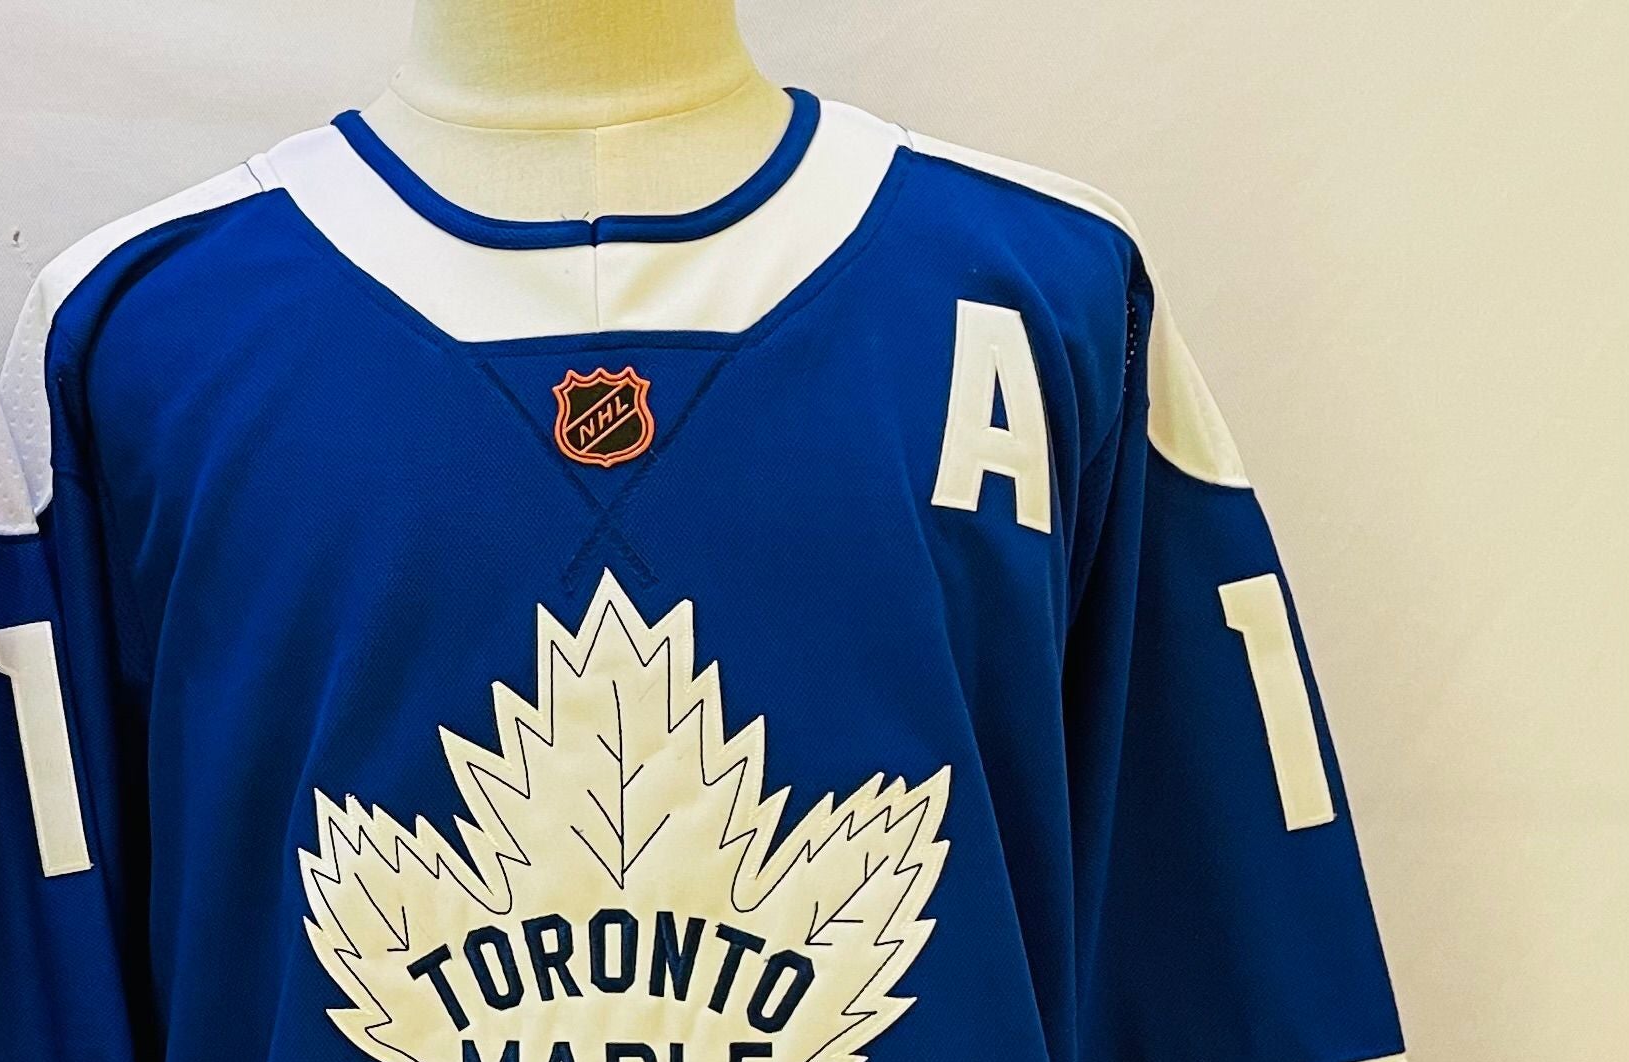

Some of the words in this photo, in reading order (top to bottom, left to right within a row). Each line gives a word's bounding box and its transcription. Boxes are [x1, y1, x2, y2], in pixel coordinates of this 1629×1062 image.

[579, 395, 629, 447] NHL
[931, 299, 1052, 535] A
[1218, 572, 1337, 832] 1
[406, 908, 815, 1034] TORONTO
